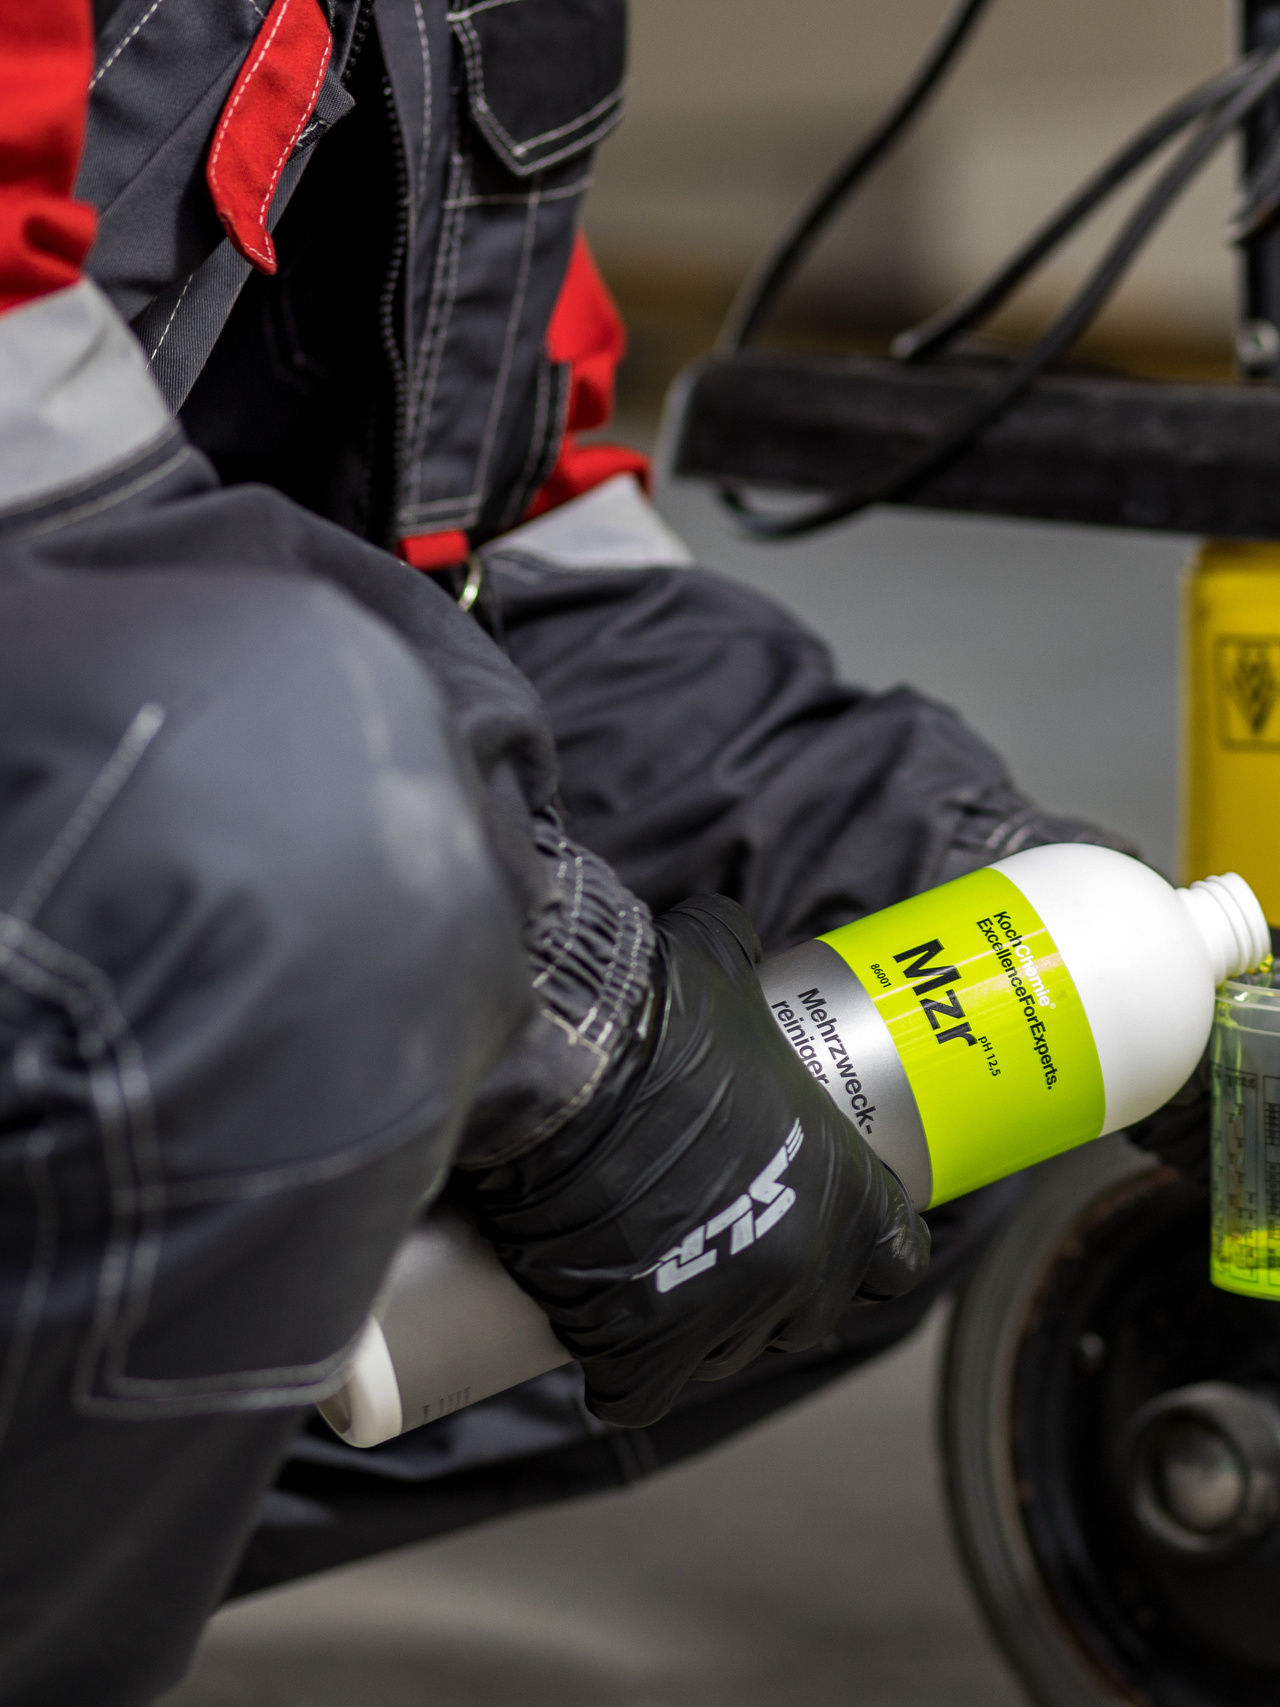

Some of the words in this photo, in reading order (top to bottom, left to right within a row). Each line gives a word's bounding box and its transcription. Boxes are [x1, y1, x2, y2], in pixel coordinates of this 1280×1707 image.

[870, 963, 892, 988] 86001
[892, 938, 978, 1047] Mzr
[976, 917, 1058, 1090] ExcellenceForExperts.
[797, 987, 876, 1134] Mehrzweck-
[977, 1036, 993, 1052] pH
[986, 1053, 1001, 1077] 12,5
